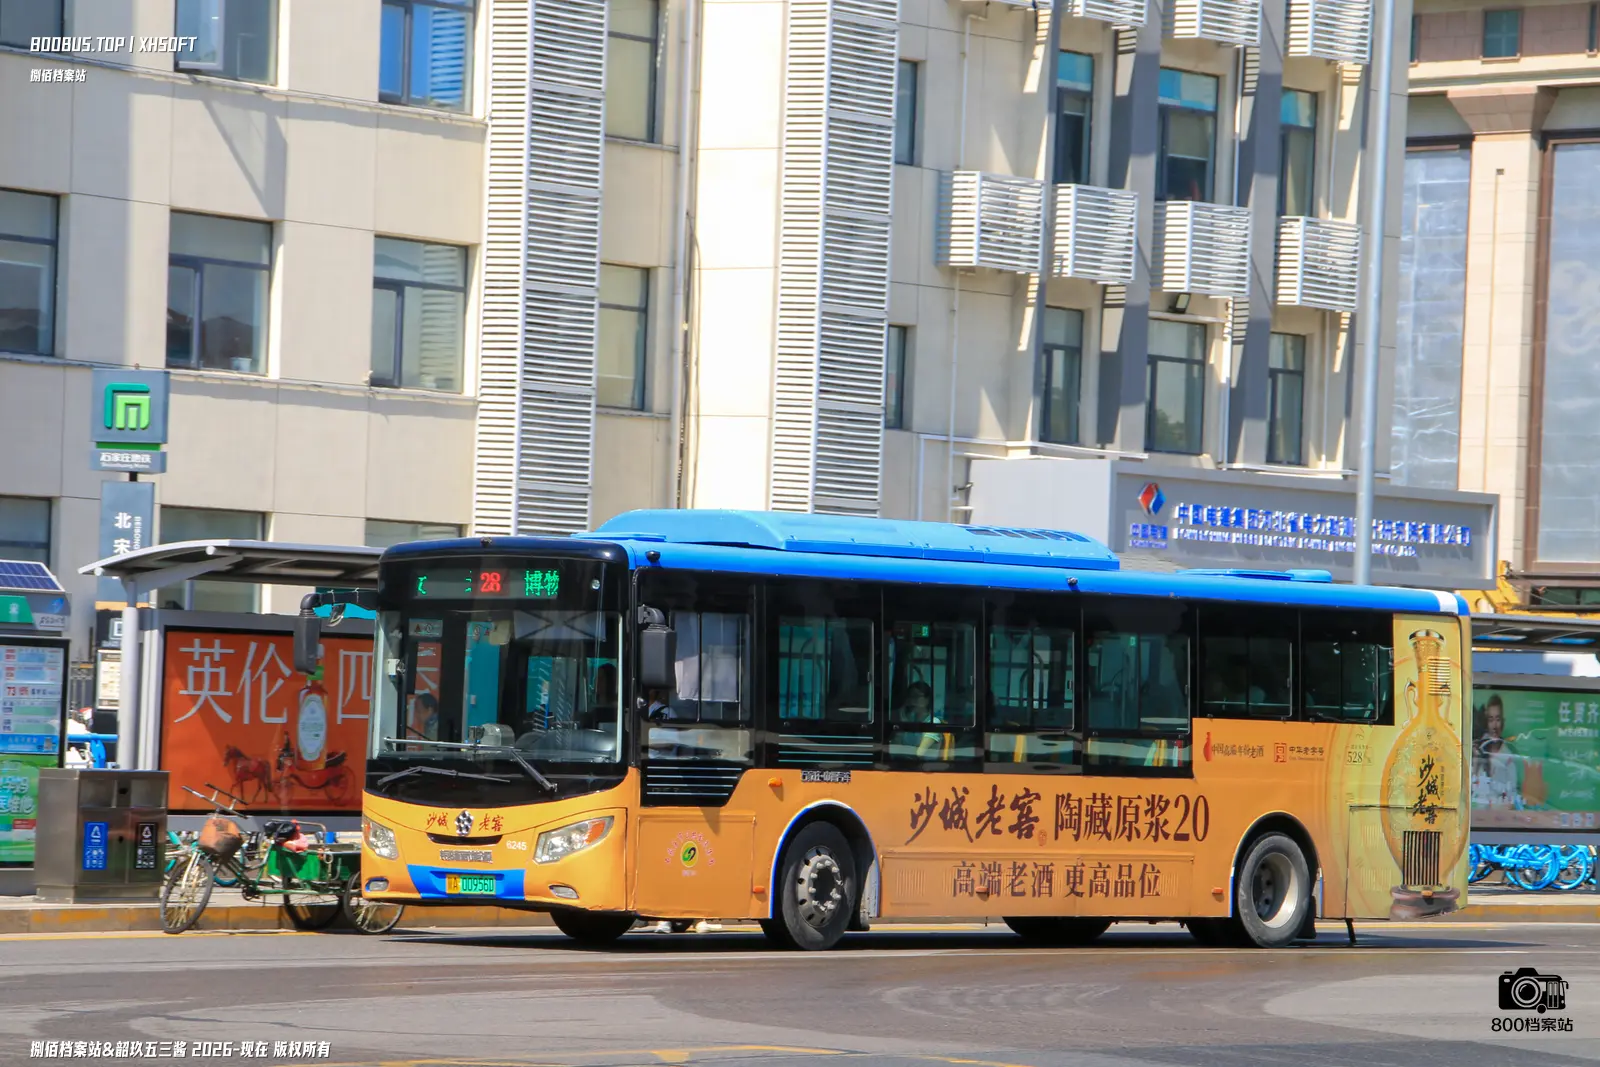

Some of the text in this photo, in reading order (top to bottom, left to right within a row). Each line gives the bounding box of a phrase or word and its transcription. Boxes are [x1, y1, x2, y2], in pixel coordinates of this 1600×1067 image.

[480, 572, 501, 593] 28
[524, 570, 560, 597] 博物
[174, 638, 292, 725] 英伦
[1347, 751, 1363, 764] 528
[1054, 793, 1210, 843] 陶藏原浆20
[506, 840, 527, 851] 6245
[952, 860, 1162, 899] 高端老酒 更高品位
